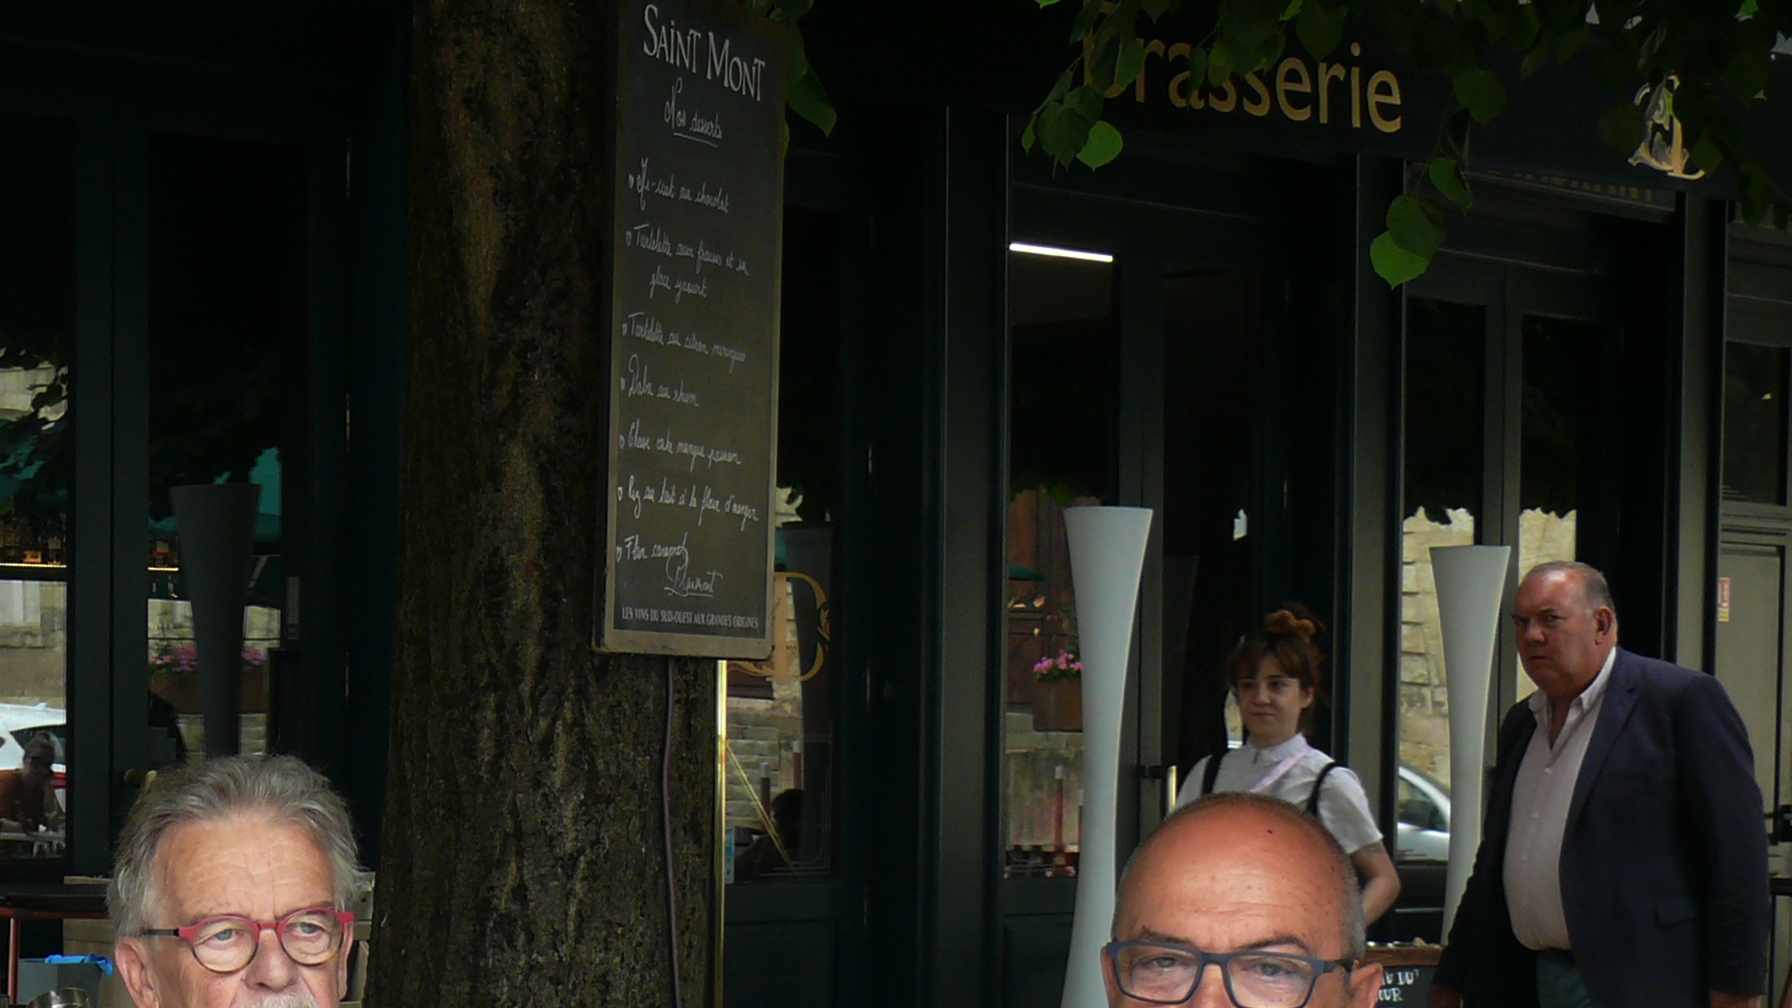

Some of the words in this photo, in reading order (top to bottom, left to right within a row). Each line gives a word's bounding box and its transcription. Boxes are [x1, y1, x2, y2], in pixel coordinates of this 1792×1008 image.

[706, 31, 765, 101] MONT
[694, 181, 729, 214] chocolat
[621, 606, 633, 620] LES
[635, 607, 649, 621] VINS
[650, 608, 660, 622] DU
[660, 609, 692, 624] SUD-OUEST
[706, 613, 732, 627] GRANDES
